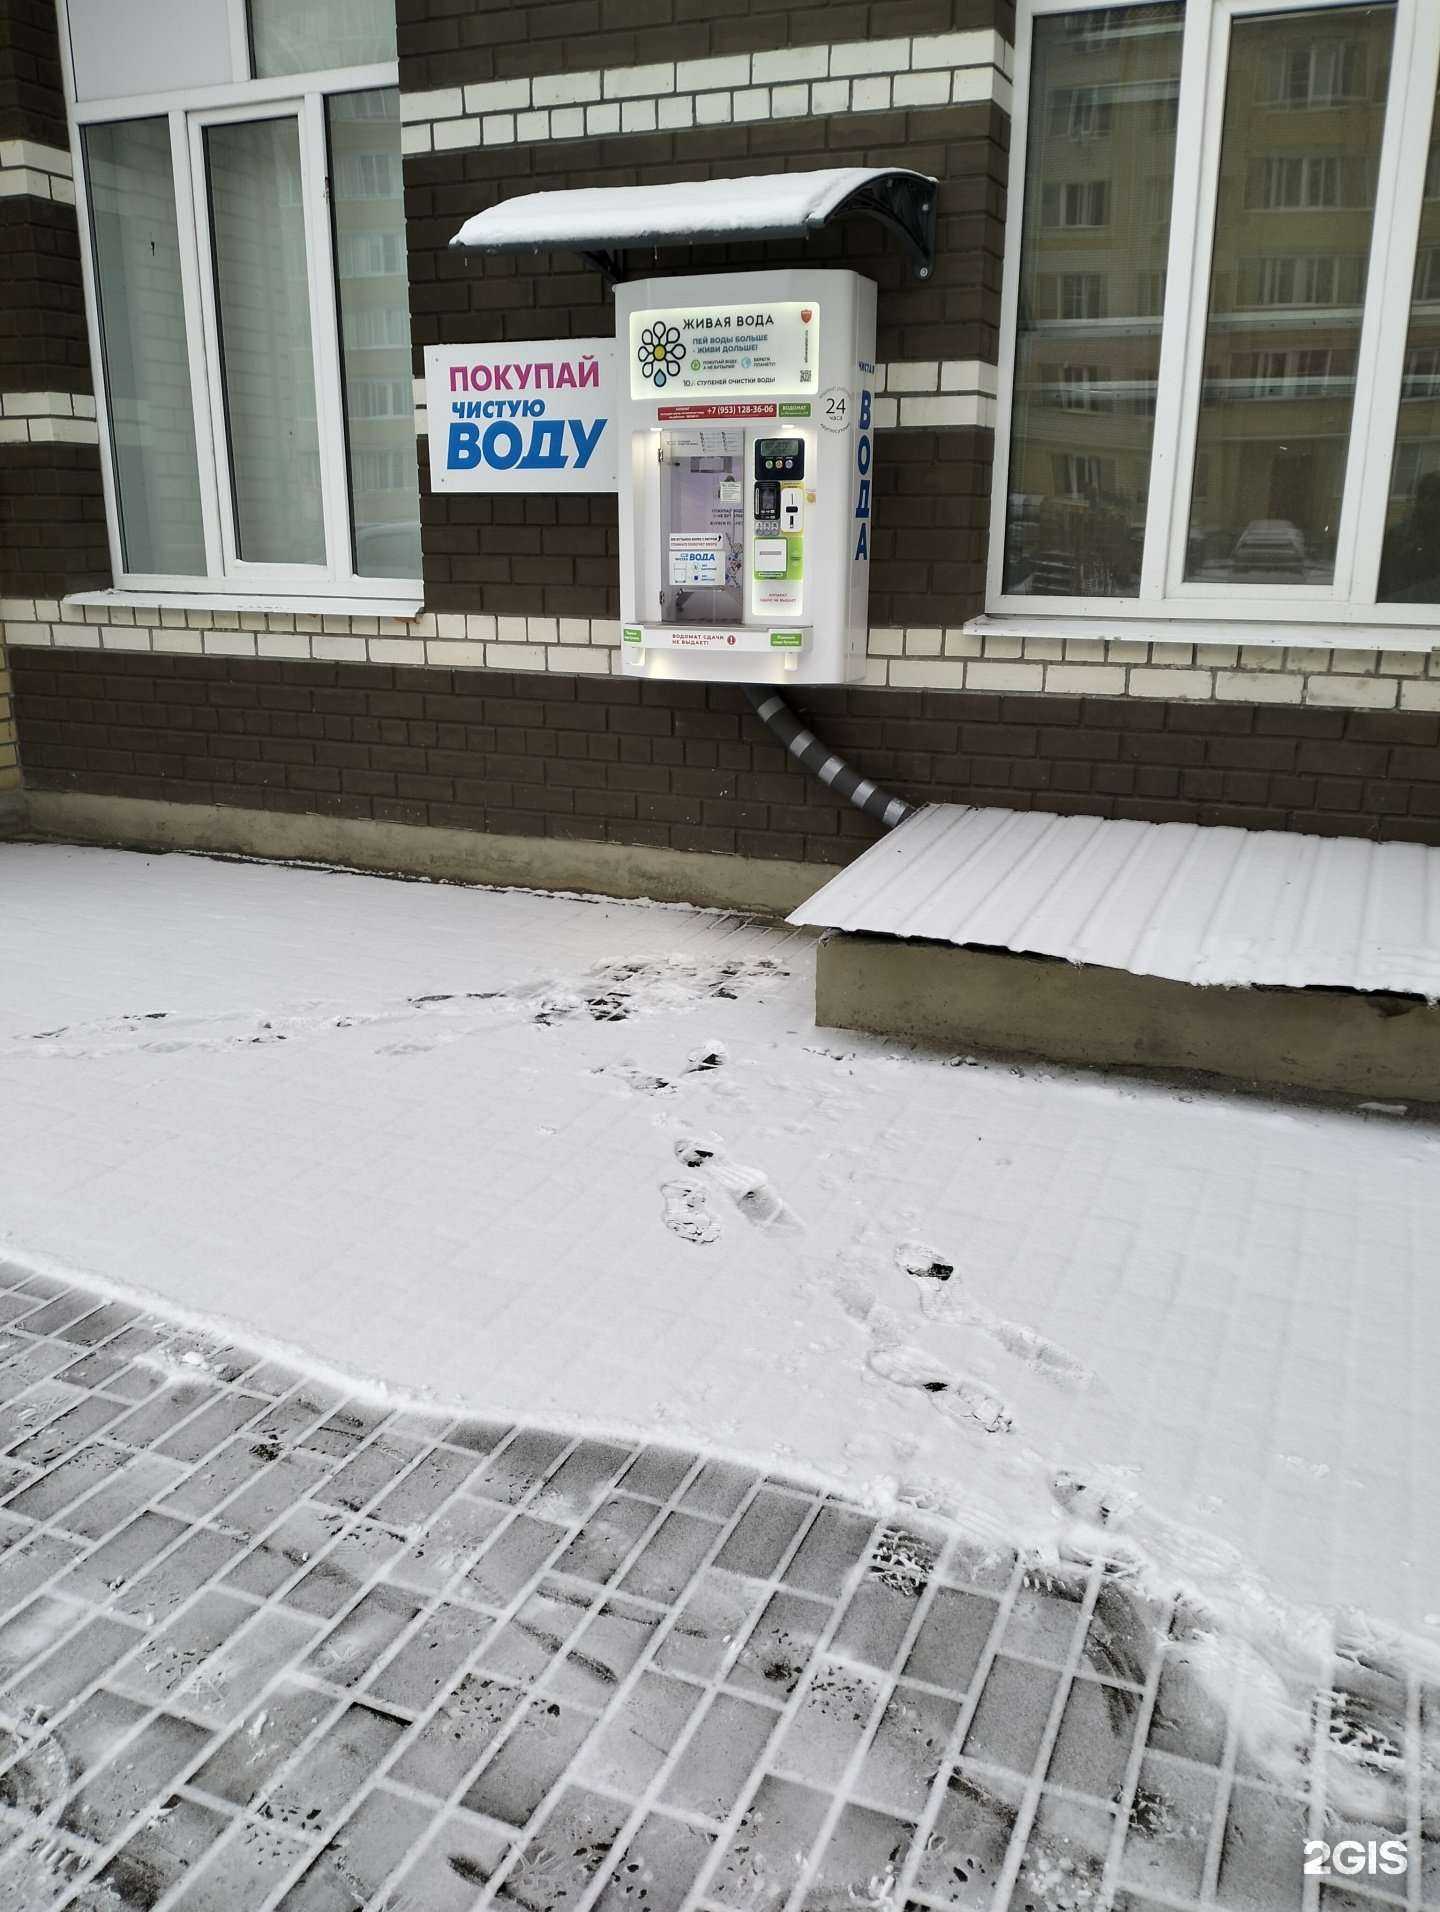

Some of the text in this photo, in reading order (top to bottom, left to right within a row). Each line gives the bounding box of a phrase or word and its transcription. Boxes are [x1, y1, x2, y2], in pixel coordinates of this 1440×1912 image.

[683, 314, 775, 330] ЖИВАЯ ВОДА
[693, 334, 769, 345] ПЕЙ ВОДЫ БОЛЬШЕ
[698, 346, 721, 354] ЖИВИ
[722, 344, 758, 353] ДОЛЬШЕ!
[449, 355, 600, 392] ПОКУПАЙ
[451, 398, 547, 419] ЧИСТУЮ
[707, 406, 717, 415] +7
[718, 405, 736, 414] (953)
[737, 404, 774, 414] 128-36-06
[825, 398, 847, 415] 24
[446, 418, 608, 471] ВОДУ
[855, 389, 873, 561] ВОДА
[689, 553, 716, 561] ВОДА
